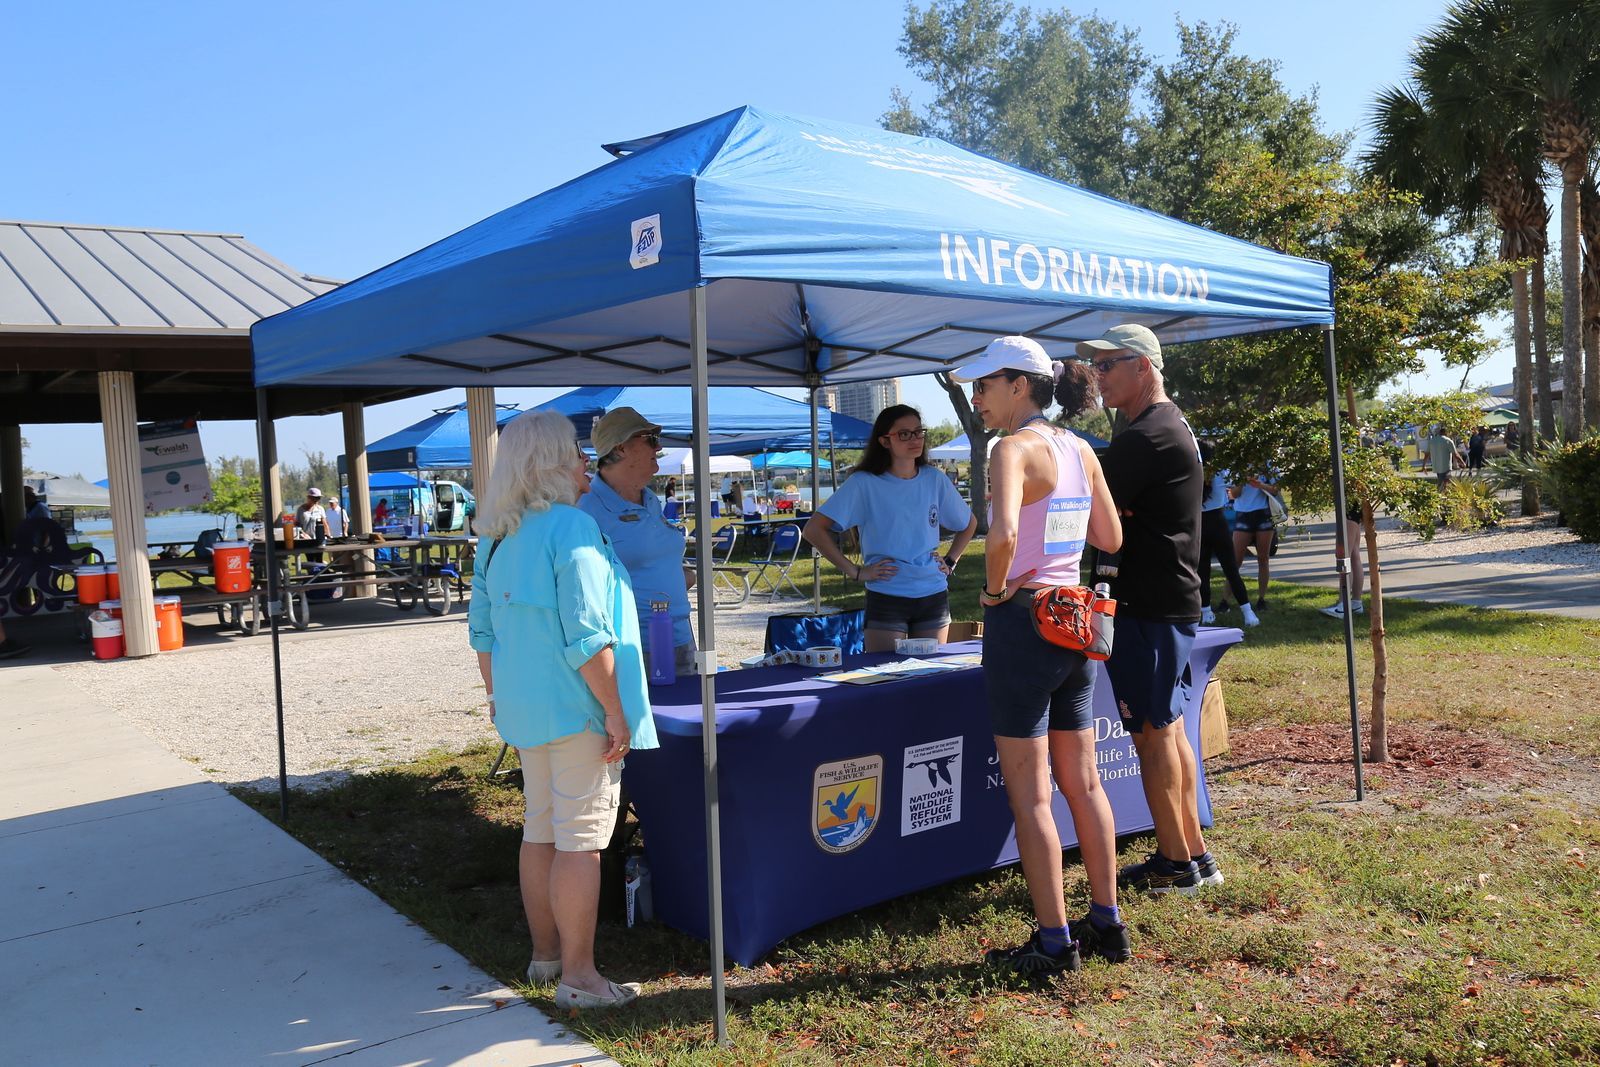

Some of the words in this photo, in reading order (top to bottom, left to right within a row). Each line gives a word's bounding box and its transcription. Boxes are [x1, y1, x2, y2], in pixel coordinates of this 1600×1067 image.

[940, 233, 1208, 304] INFORMATION
[819, 771, 837, 779] FISH
[845, 763, 879, 774] WILDLIFE
[833, 772, 865, 782] SERVICE
[909, 787, 955, 804] NATIONAL
[909, 795, 954, 812] WILDLIFE
[910, 803, 953, 821] REFUGE
[911, 812, 952, 830] SYSTEM
